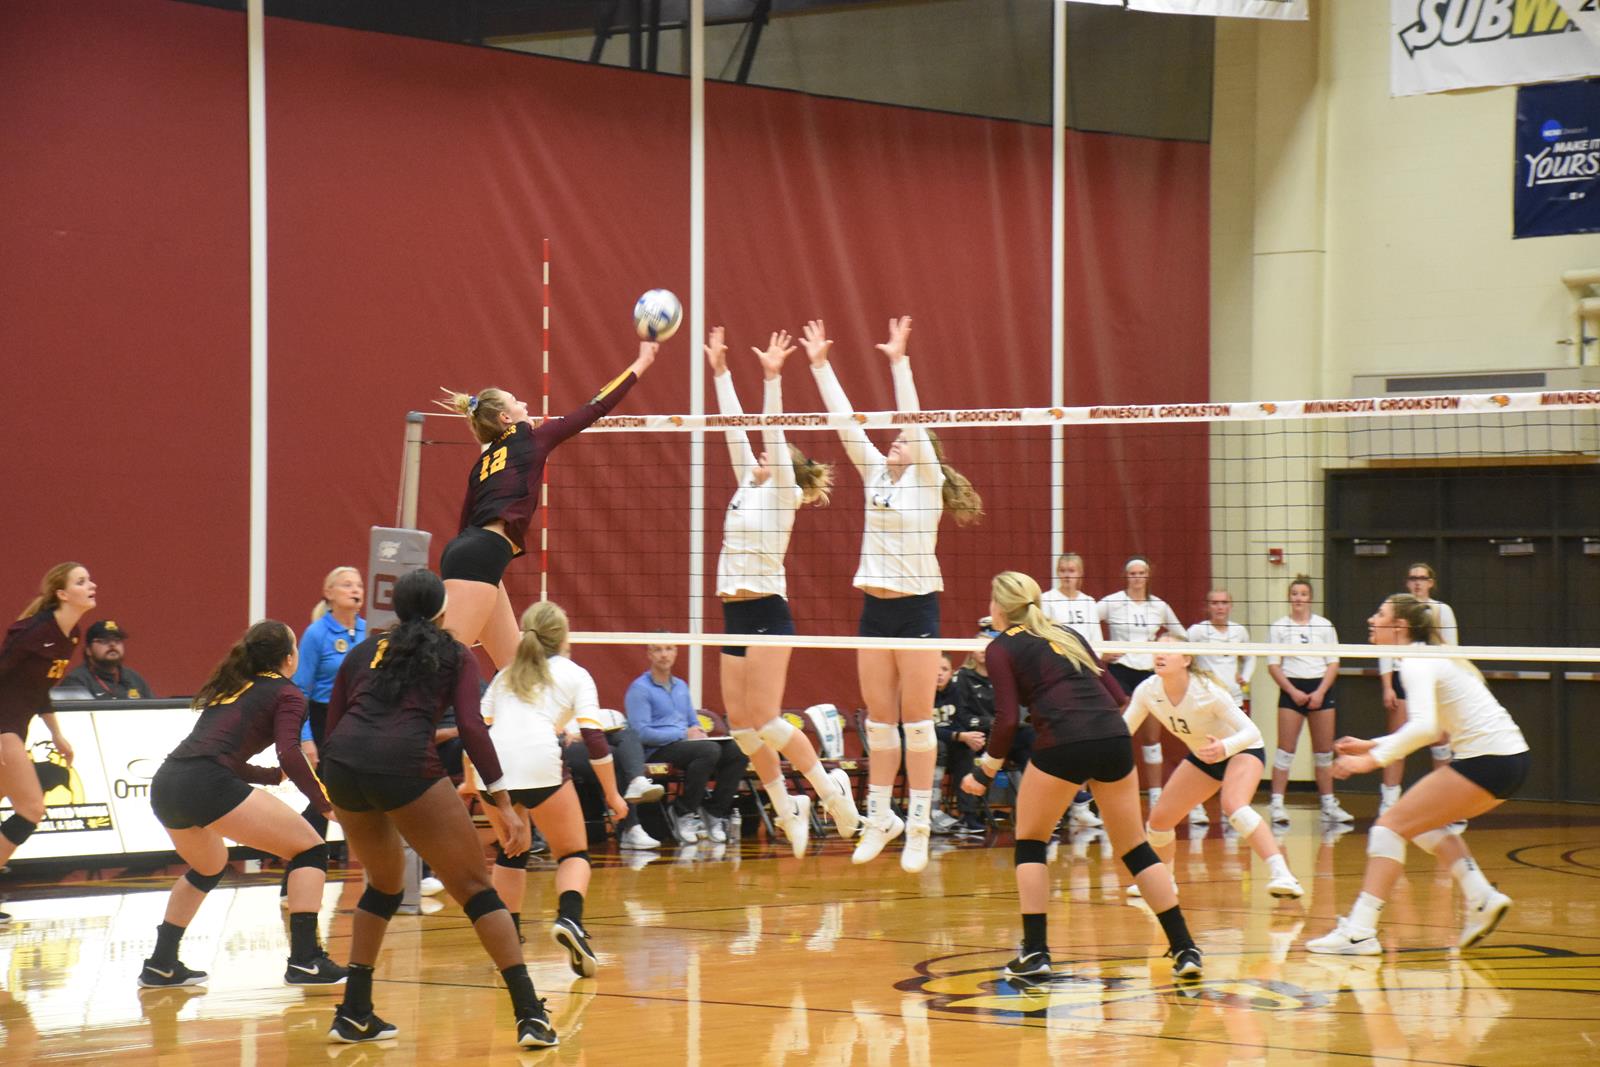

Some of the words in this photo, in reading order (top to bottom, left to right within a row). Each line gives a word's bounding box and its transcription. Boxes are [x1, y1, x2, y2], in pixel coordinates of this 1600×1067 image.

[1552, 141, 1589, 153] MAKE
[1524, 146, 1600, 188] YOURS
[1089, 407, 1154, 419] MINNESOTA
[1159, 405, 1230, 417] CROOKSTON
[1304, 400, 1375, 414] MINNESOTA
[1379, 396, 1460, 411] CROOKSTON
[705, 415, 762, 426] MINNESOTA
[766, 415, 828, 425] CROOKSTON
[892, 412, 951, 424] MINNESOTA
[955, 410, 1022, 422] CROOKSTON
[479, 446, 507, 481] 12
[1068, 610, 1084, 624] 15
[1133, 614, 1147, 627] 11
[1169, 716, 1191, 734] 13
